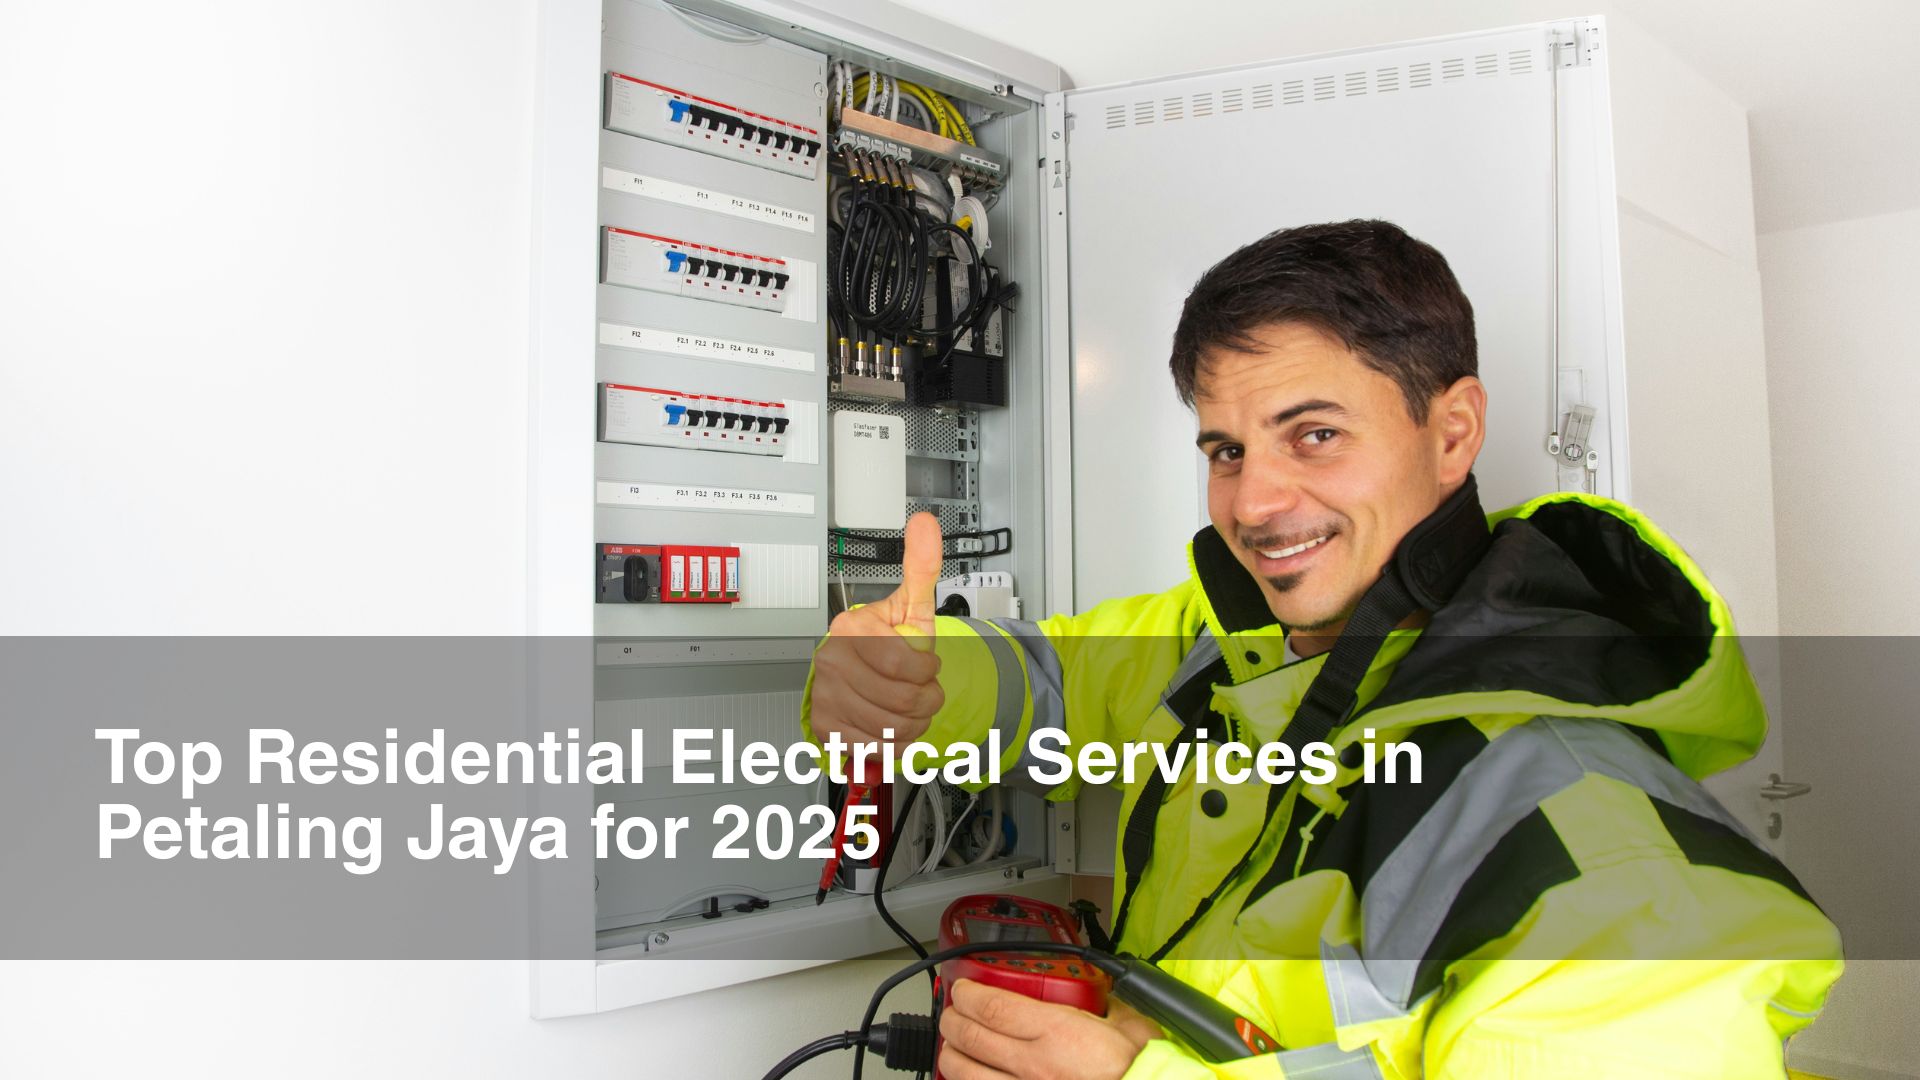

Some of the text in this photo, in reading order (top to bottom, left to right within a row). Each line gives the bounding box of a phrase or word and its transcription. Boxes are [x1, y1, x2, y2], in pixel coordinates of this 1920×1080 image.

[696, 191, 709, 199] F1.1
[731, 199, 744, 208] F1.2
[676, 336, 689, 344] F2.1
[695, 338, 707, 347] F2.2
[712, 341, 725, 350] F2.3
[730, 344, 742, 352] F2.4
[747, 346, 759, 355] F2.5
[763, 348, 775, 357] F2.6
[676, 488, 689, 497] F3.1
[695, 489, 708, 498] F3.2
[713, 490, 726, 499] F3.3
[731, 491, 743, 500] F3.4
[748, 492, 761, 501] F3.5
[766, 493, 778, 502] F3.6
[623, 646, 632, 654] Q1
